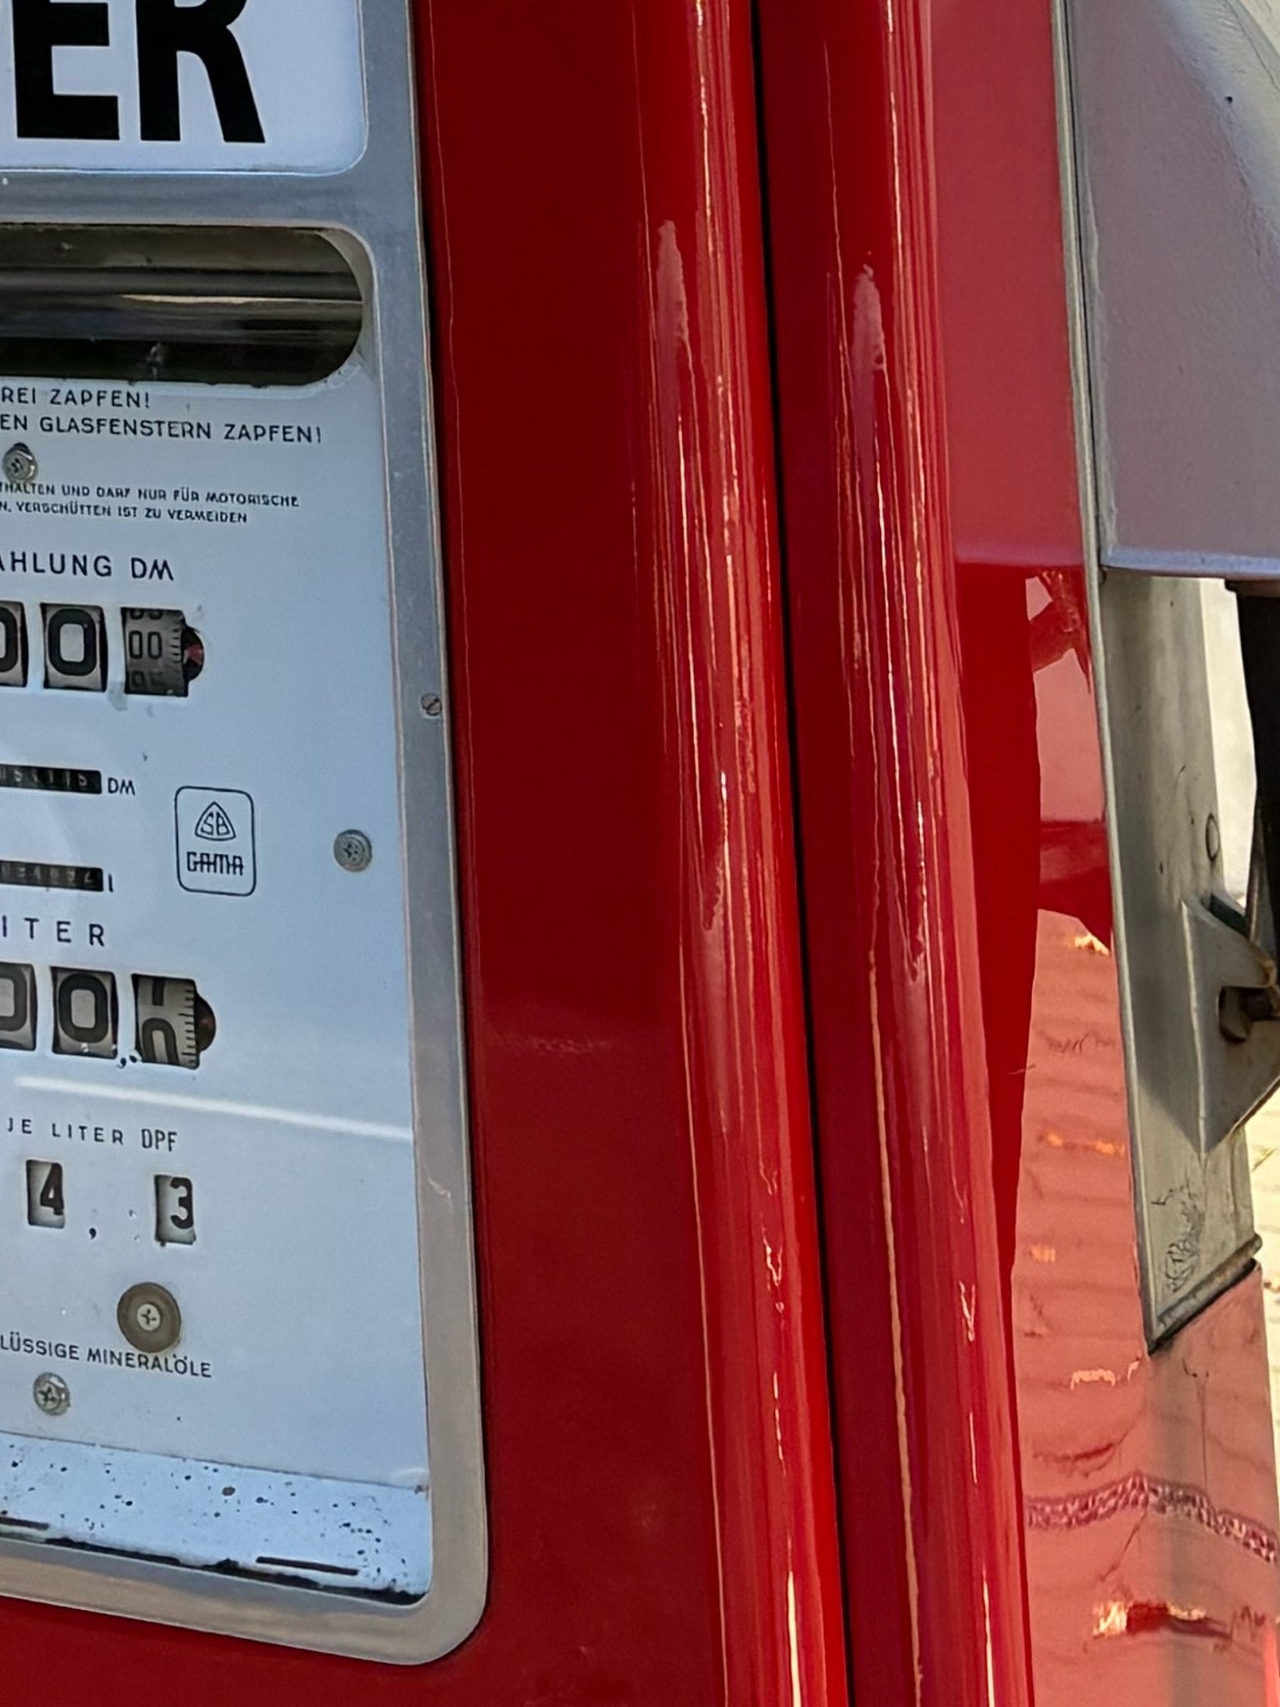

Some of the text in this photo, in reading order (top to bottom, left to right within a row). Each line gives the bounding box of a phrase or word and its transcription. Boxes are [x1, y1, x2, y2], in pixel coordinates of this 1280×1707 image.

[50, 389, 149, 409] ZAPFEN!
[40, 416, 211, 439] GLASFENSTERN
[224, 424, 321, 443] ZAPFEN!
[62, 485, 90, 496] UND
[96, 487, 130, 498] DARF
[138, 489, 166, 500] NUR
[174, 487, 199, 502] FÜR
[205, 492, 299, 507] MOTORISCHE
[16, 501, 111, 516] VERSCHÜTTEN
[118, 506, 137, 517] IST
[145, 508, 161, 519] ZU
[167, 509, 247, 523] VERMEIDEN
[131, 557, 174, 581] DM
[108, 777, 135, 795] DM
[8, 1117, 32, 1134] JE
[52, 1123, 123, 1145] LITER
[87, 1348, 211, 1378] MINERALÖLE
